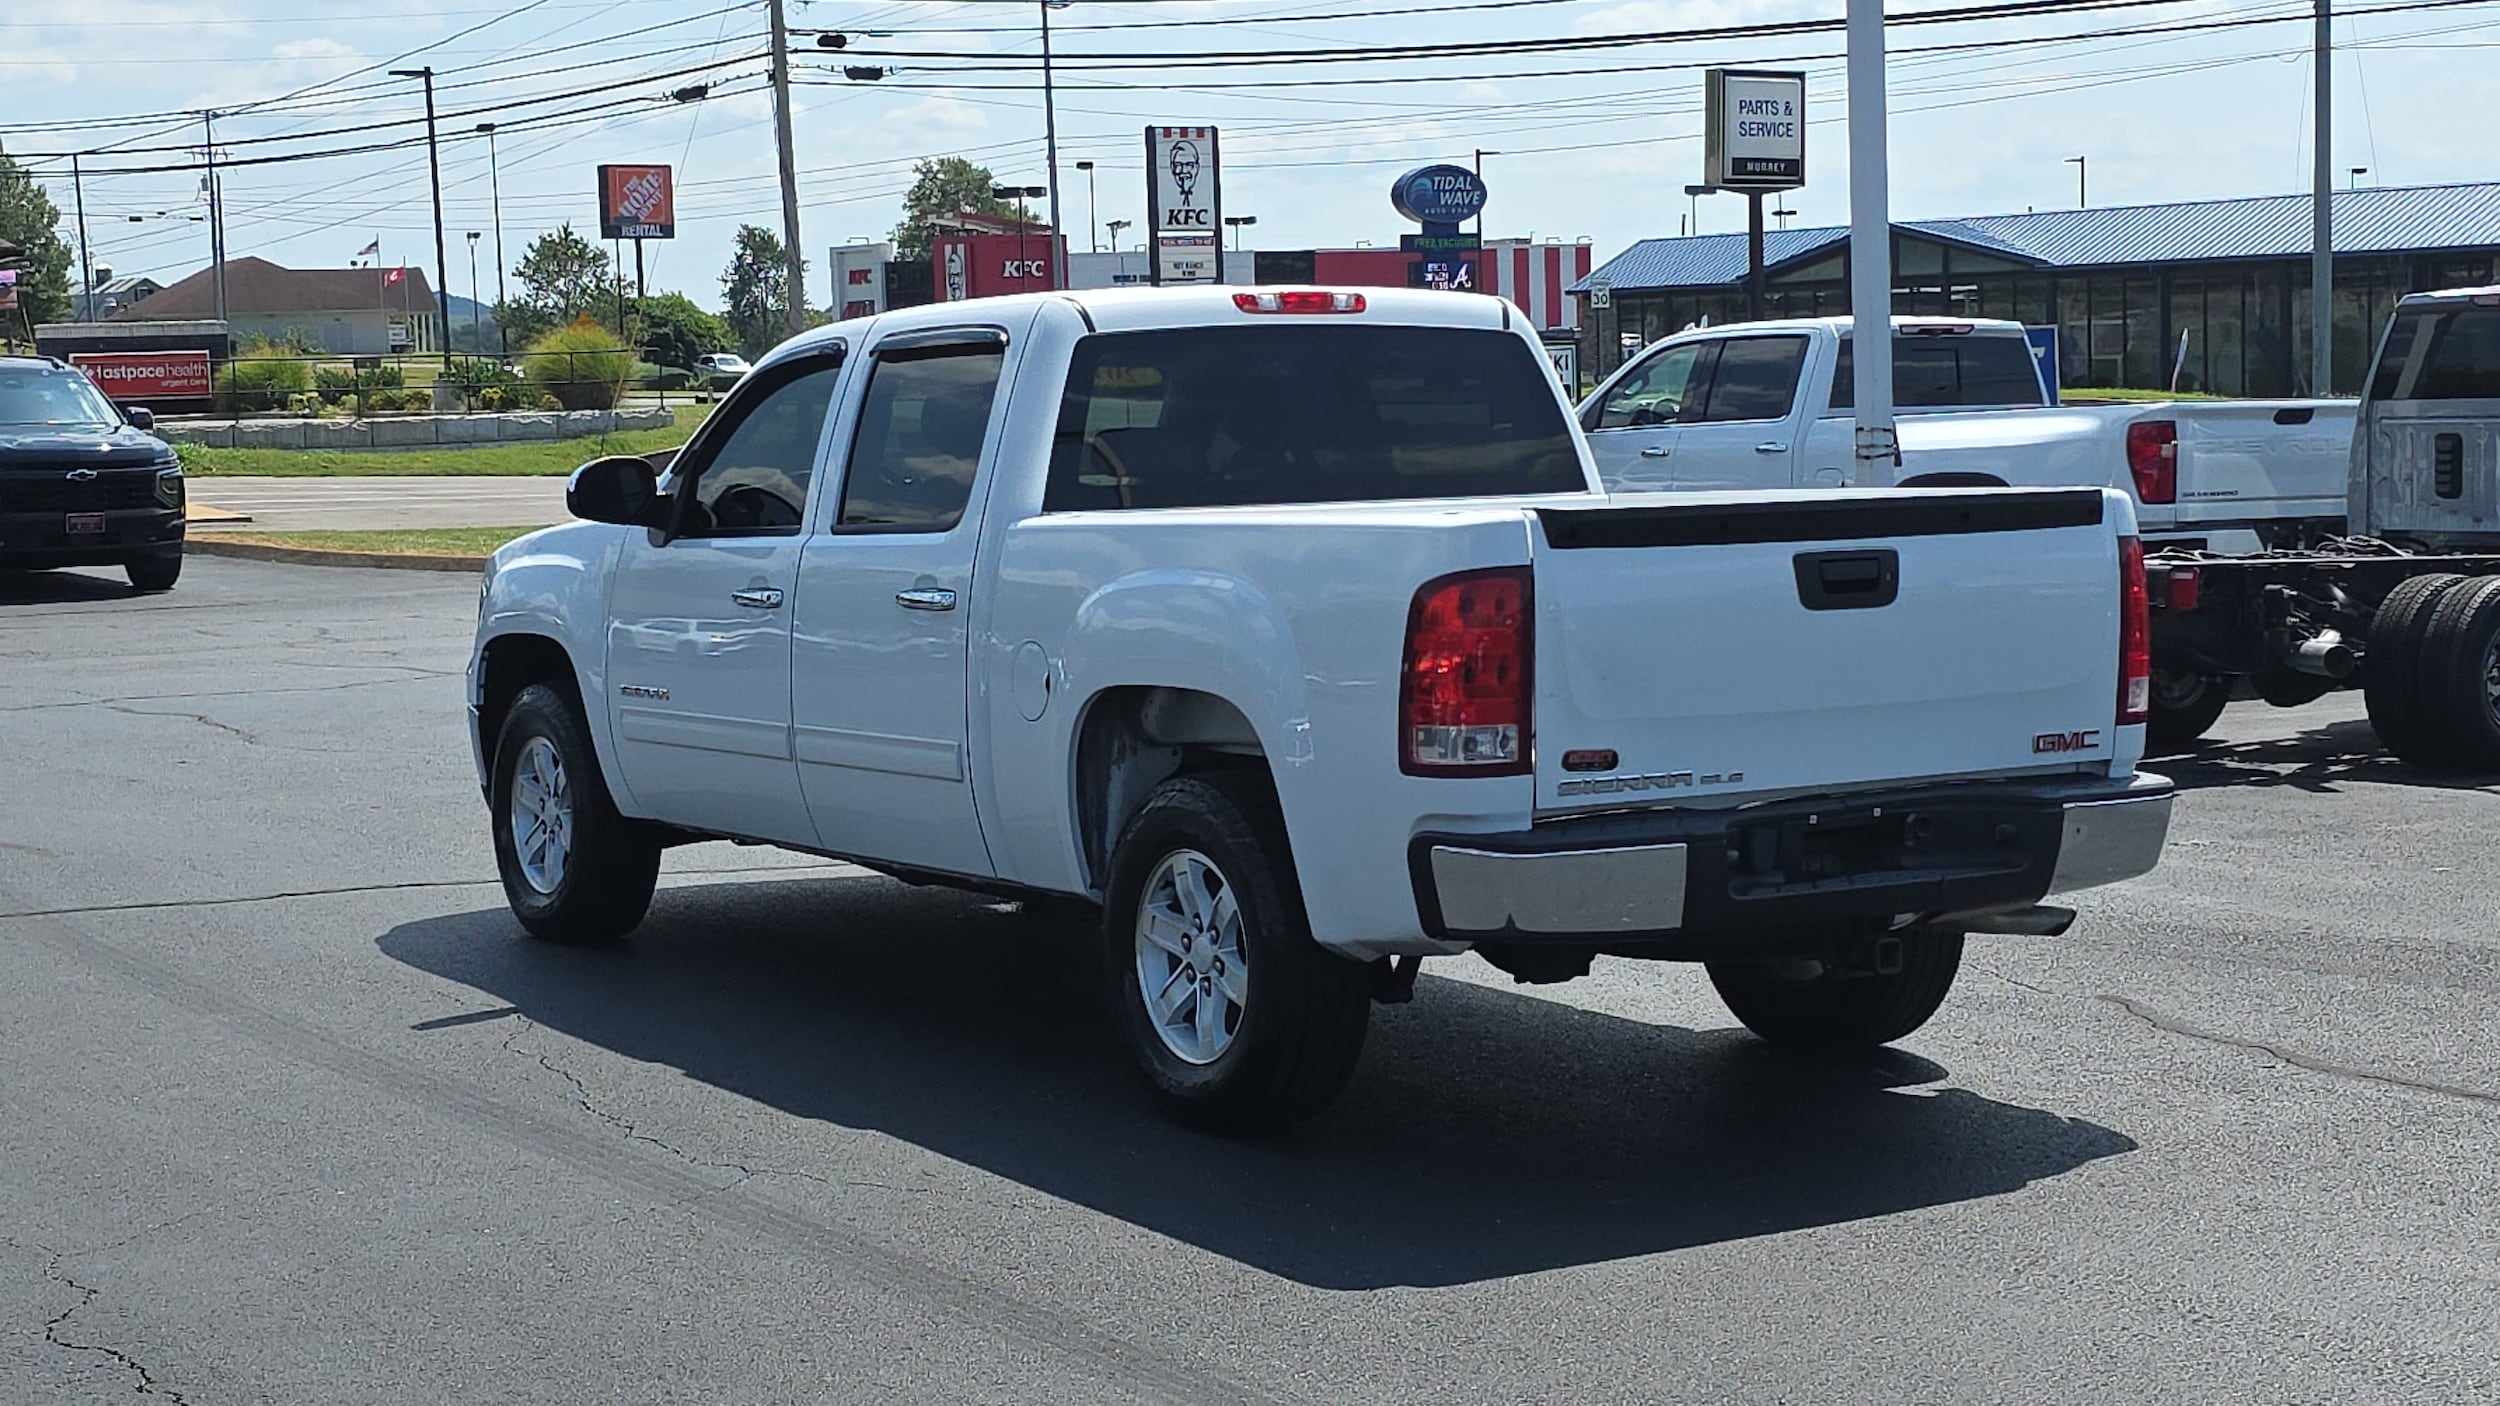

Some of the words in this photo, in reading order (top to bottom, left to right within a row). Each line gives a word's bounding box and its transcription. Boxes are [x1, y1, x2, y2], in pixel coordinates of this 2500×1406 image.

[1739, 100, 1780, 116] PARTS
[1783, 101, 1794, 116] &
[1738, 121, 1795, 138] SERVICE
[1433, 175, 1472, 191] TIDAL
[618, 170, 661, 218] HOME
[1439, 191, 1481, 206] WAVE
[1166, 208, 1209, 226] KFC
[621, 223, 664, 237] RENTAL
[848, 269, 872, 285] KFC
[1002, 260, 1045, 278] KFC
[1592, 293, 1608, 306] 30
[165, 359, 208, 378] health
[2031, 729, 2100, 754] GMC
[1557, 770, 1694, 797] SIERRA
